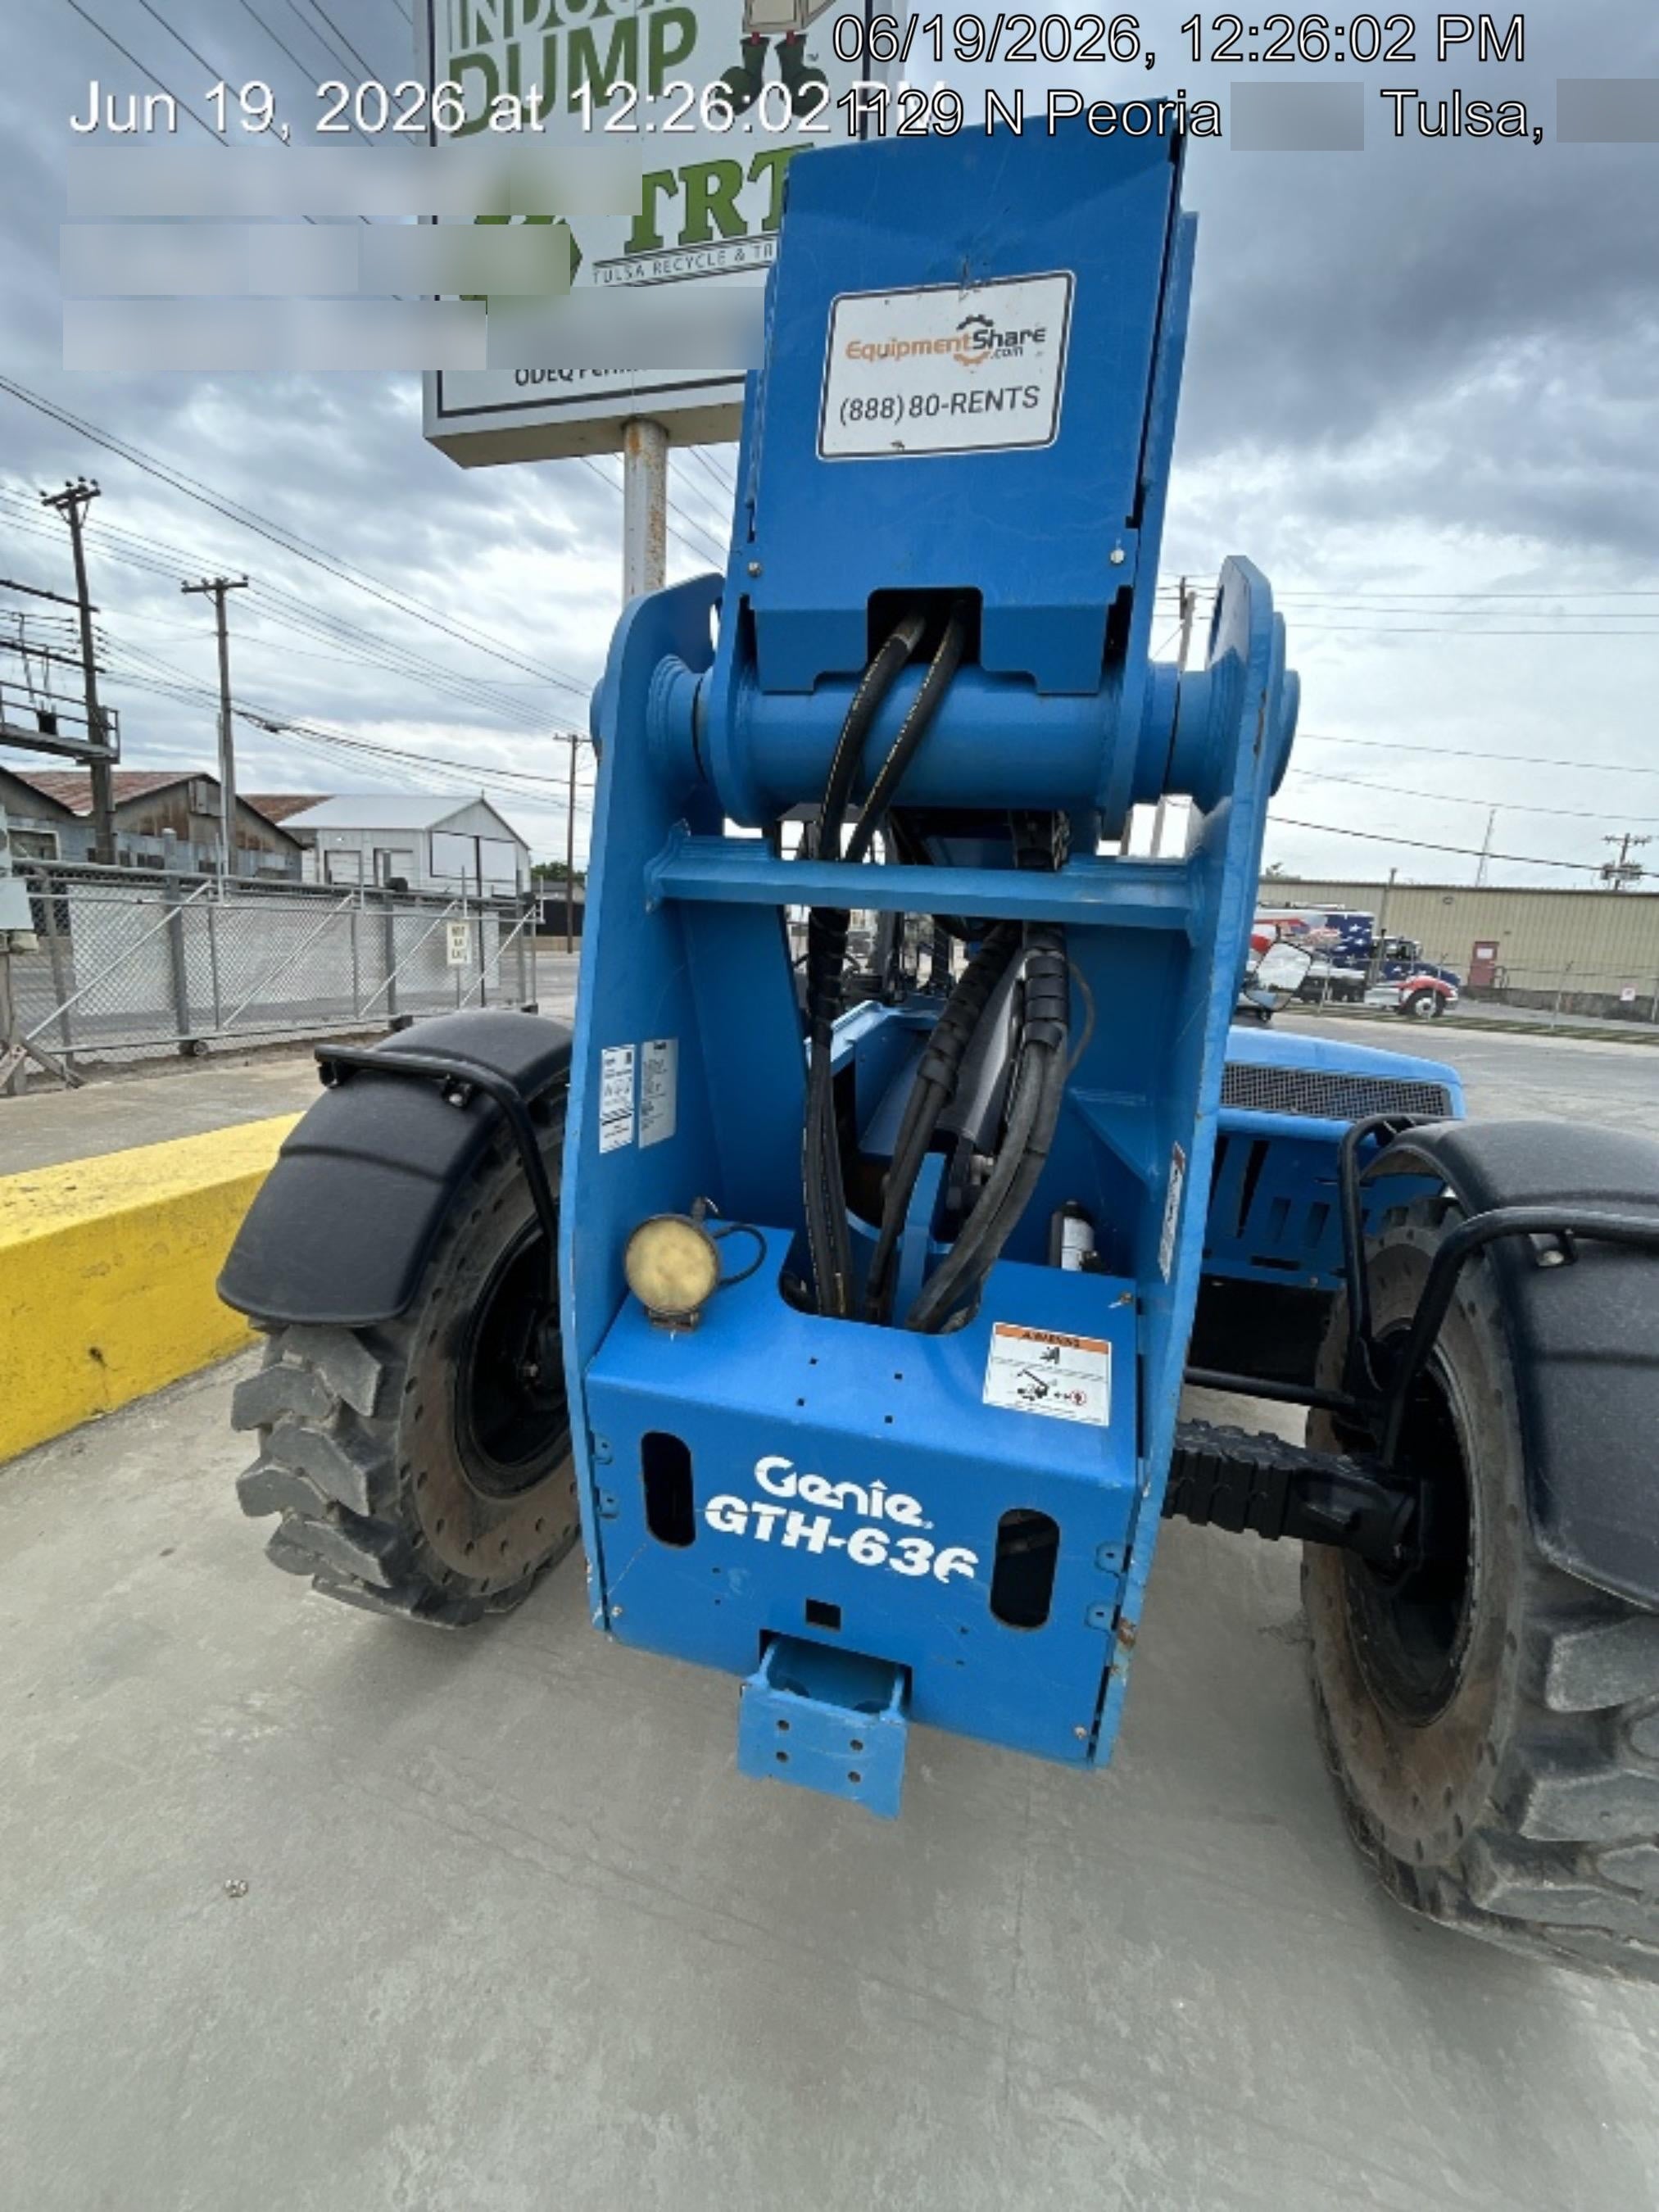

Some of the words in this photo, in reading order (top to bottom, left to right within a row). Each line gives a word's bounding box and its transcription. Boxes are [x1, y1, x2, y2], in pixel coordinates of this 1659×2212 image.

[450, 7, 696, 138] DUMP
[593, 264, 645, 284] TULSA
[653, 251, 726, 275] RECYCLE
[735, 248, 745, 261] &
[845, 328, 1048, 361] EquipmentShare
[840, 395, 903, 426] (888)
[909, 385, 1040, 418] 80-RENTS
[754, 1456, 924, 1528] Genie
